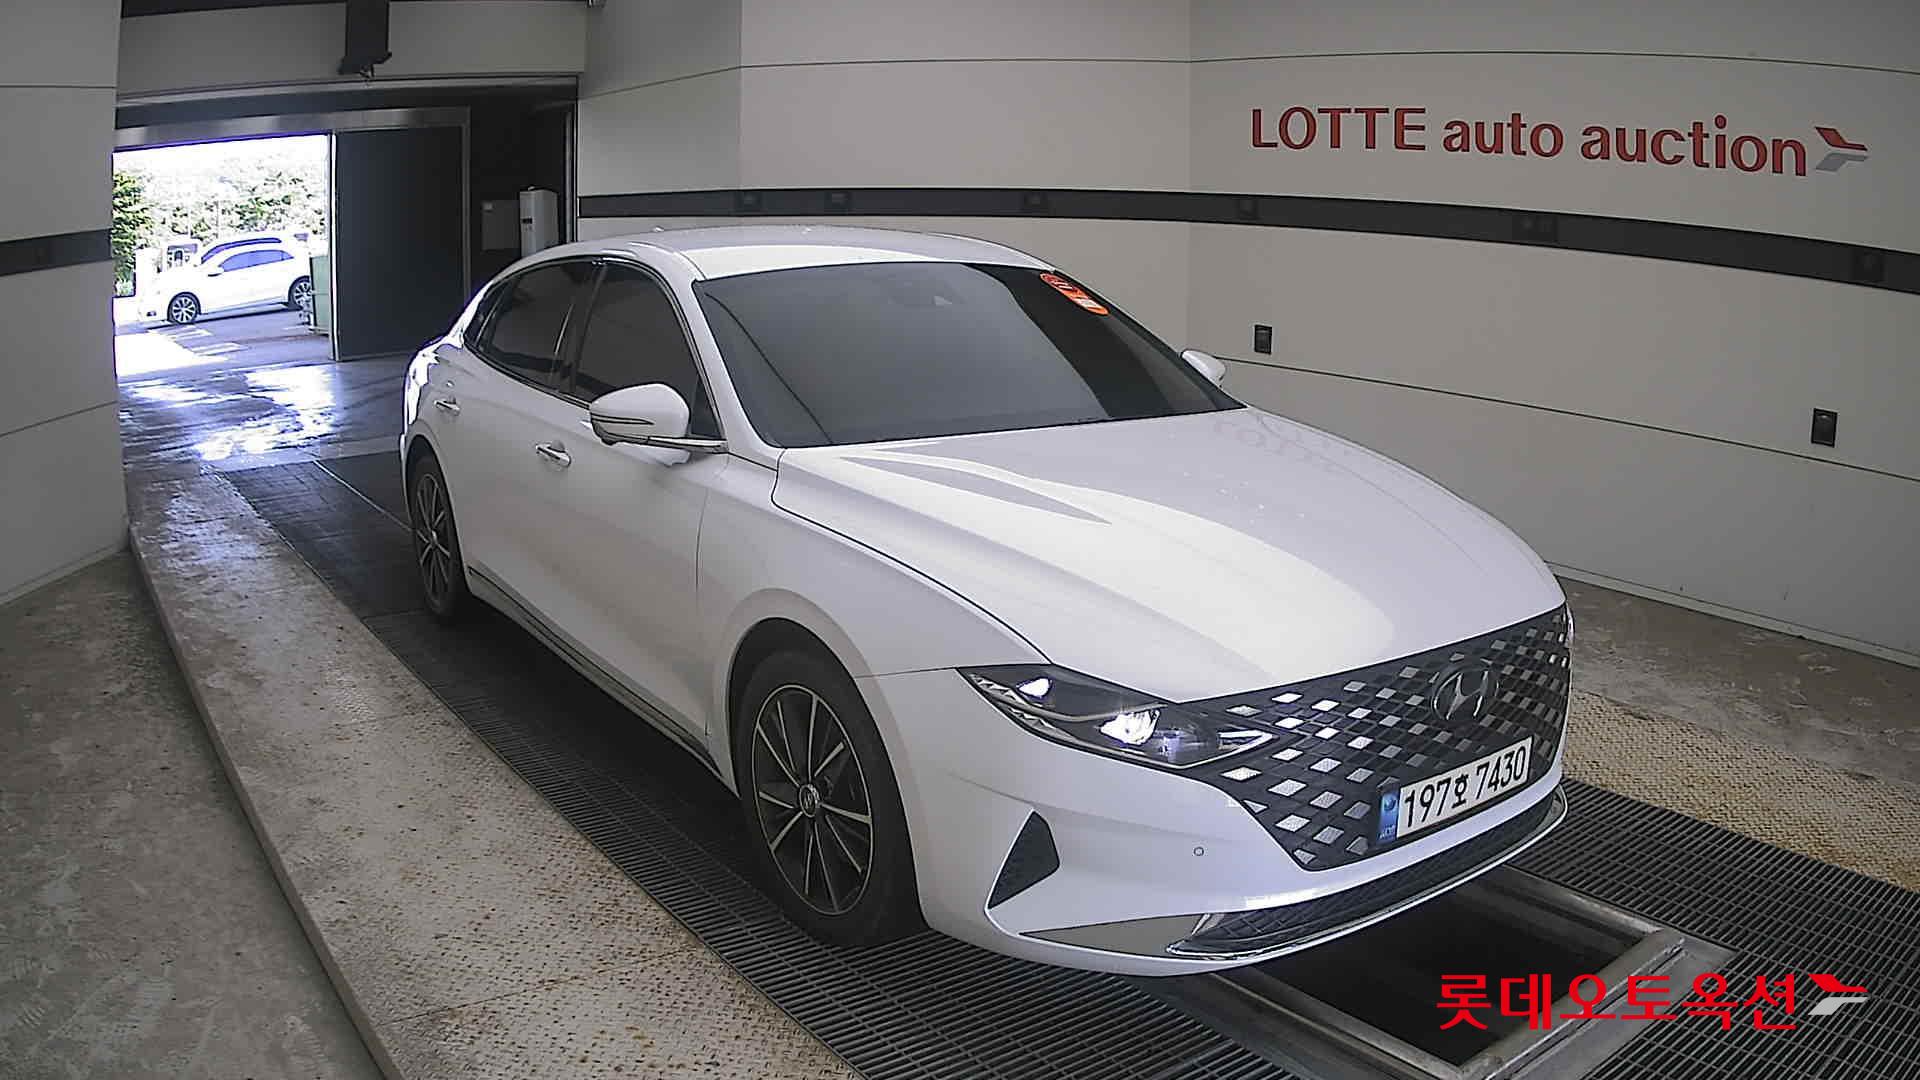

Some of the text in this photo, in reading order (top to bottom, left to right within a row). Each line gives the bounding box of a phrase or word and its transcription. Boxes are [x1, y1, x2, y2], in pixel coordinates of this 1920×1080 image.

[1251, 106, 1807, 177] LOTTE auto auction
[1405, 746, 1526, 828] 197호 7430
